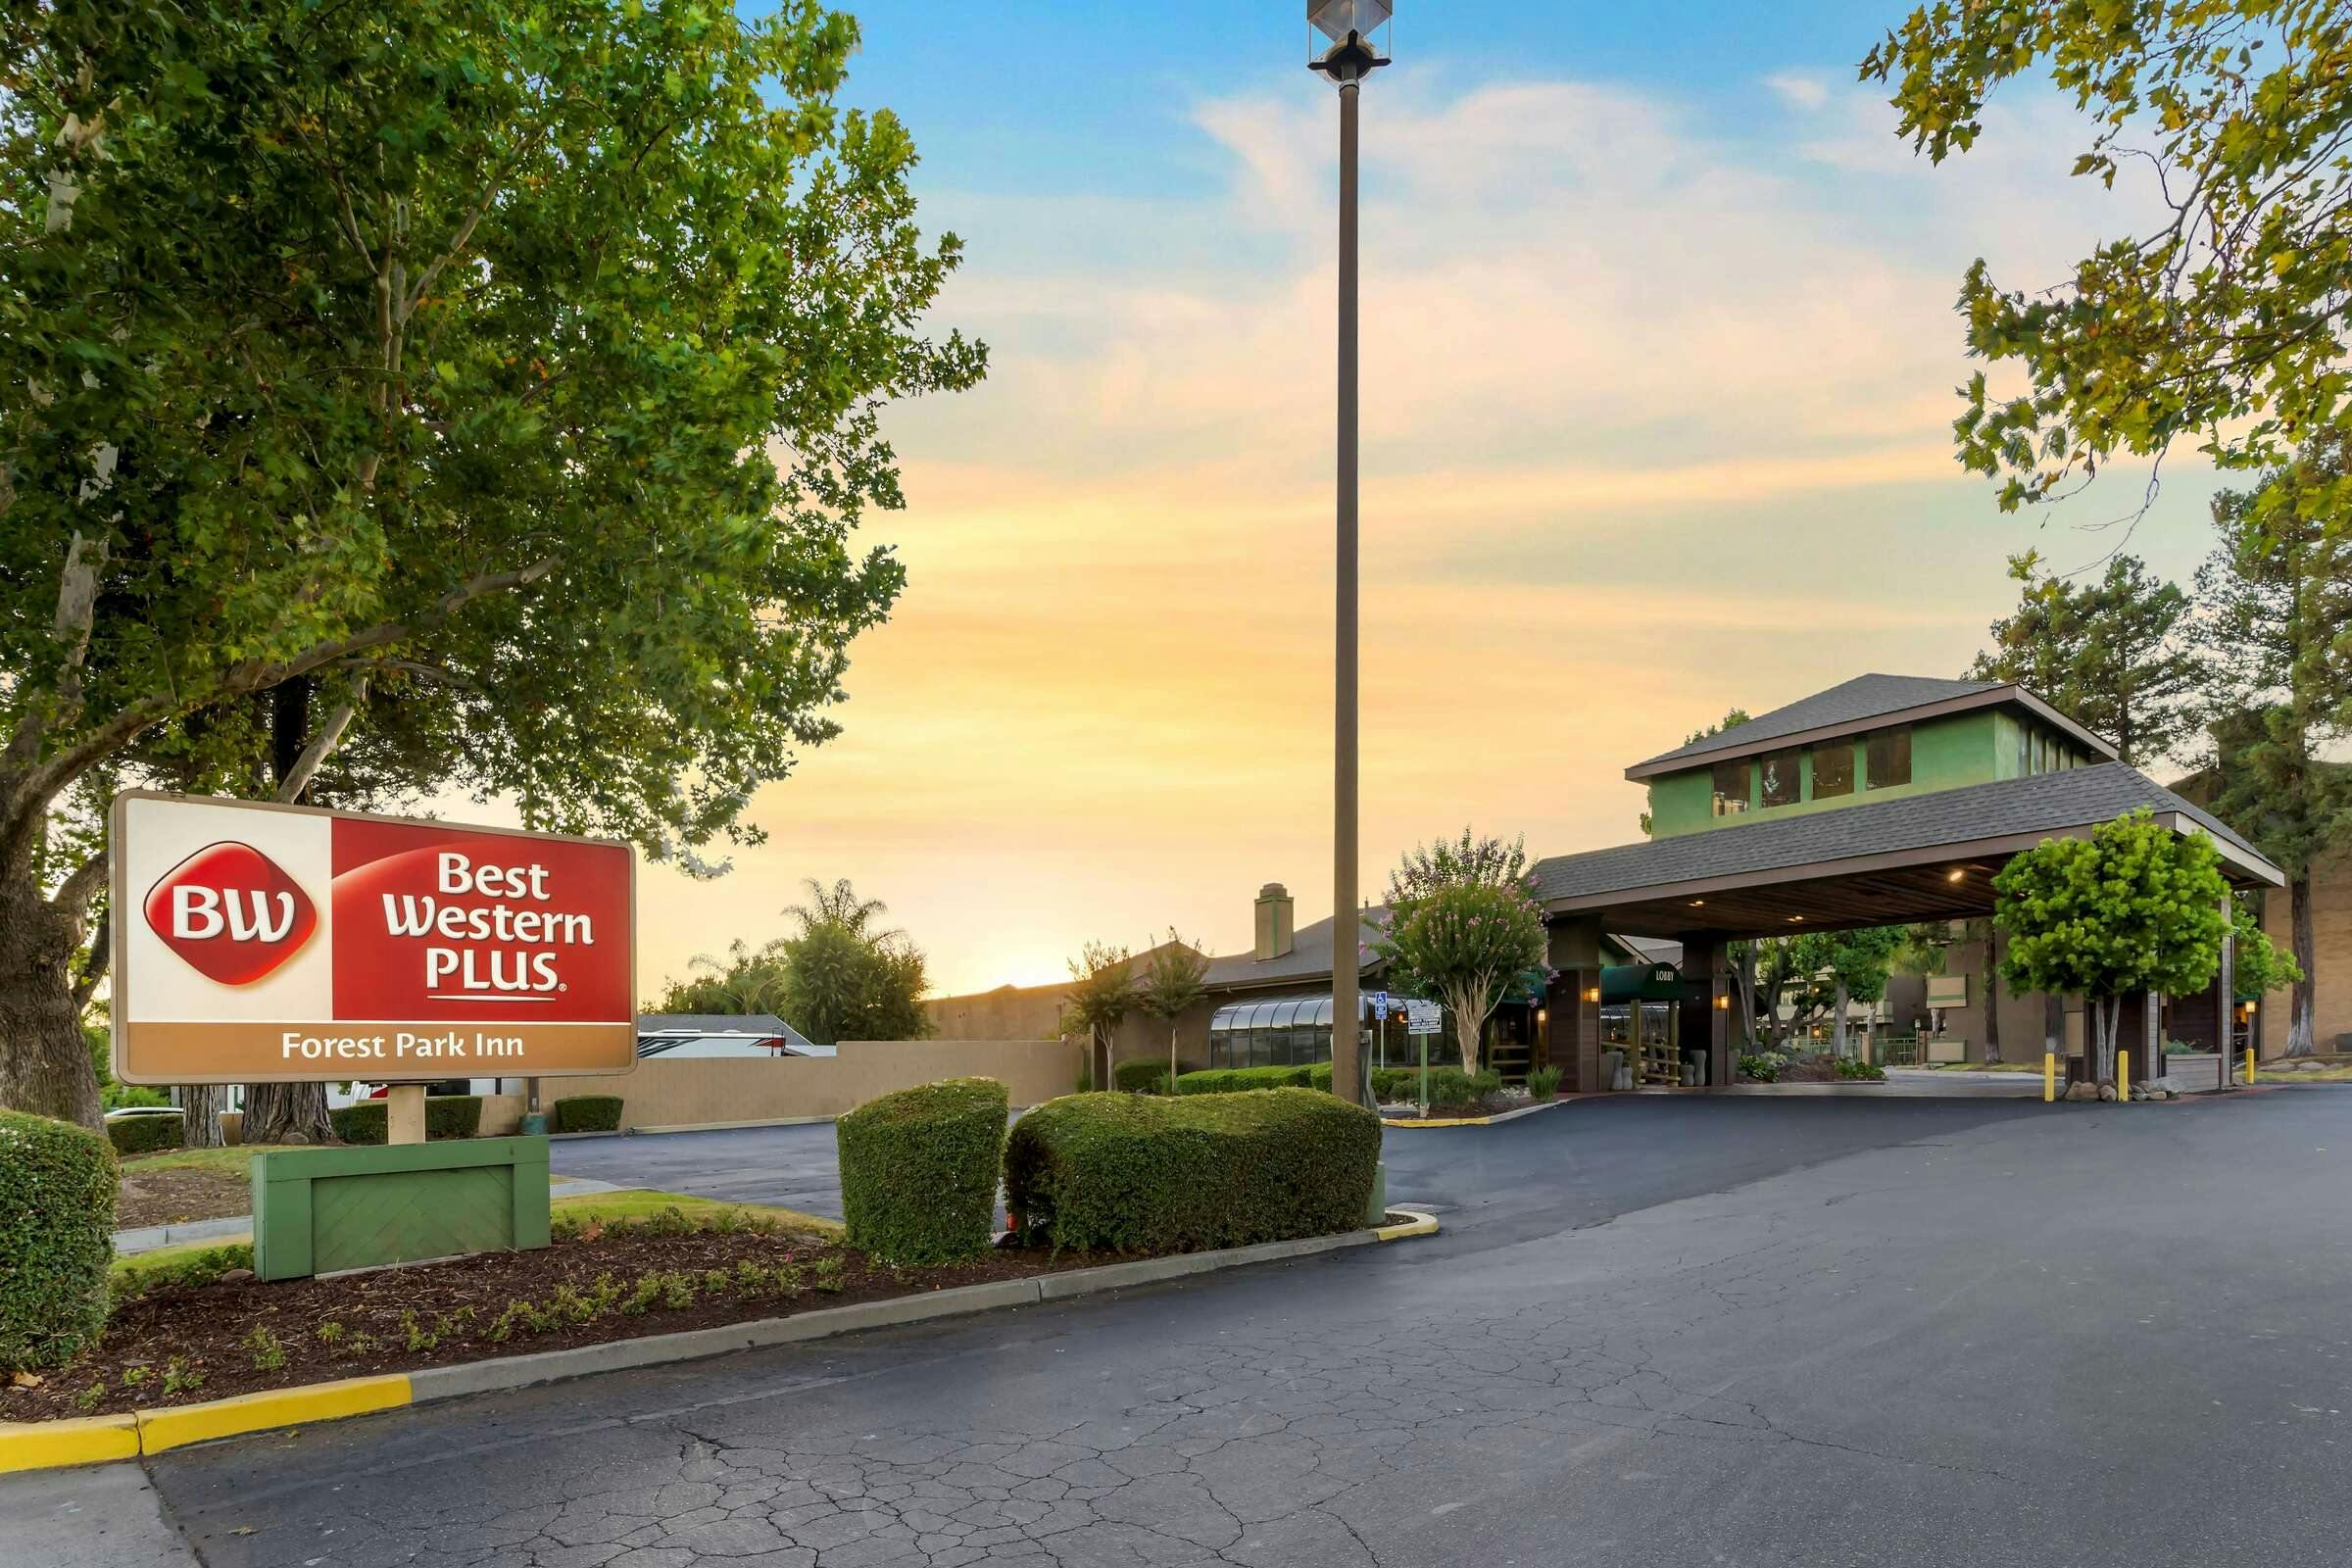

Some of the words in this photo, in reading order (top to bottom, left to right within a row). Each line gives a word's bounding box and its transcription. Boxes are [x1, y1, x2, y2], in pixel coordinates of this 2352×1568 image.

[438, 853, 551, 901] Best
[172, 885, 295, 943] BW
[381, 893, 594, 945] Western
[426, 948, 559, 992] PLUS
[1656, 970, 1674, 981] LOBBY
[281, 1032, 386, 1058] Forest
[395, 1031, 466, 1056] Park
[475, 1032, 524, 1056] Inn
